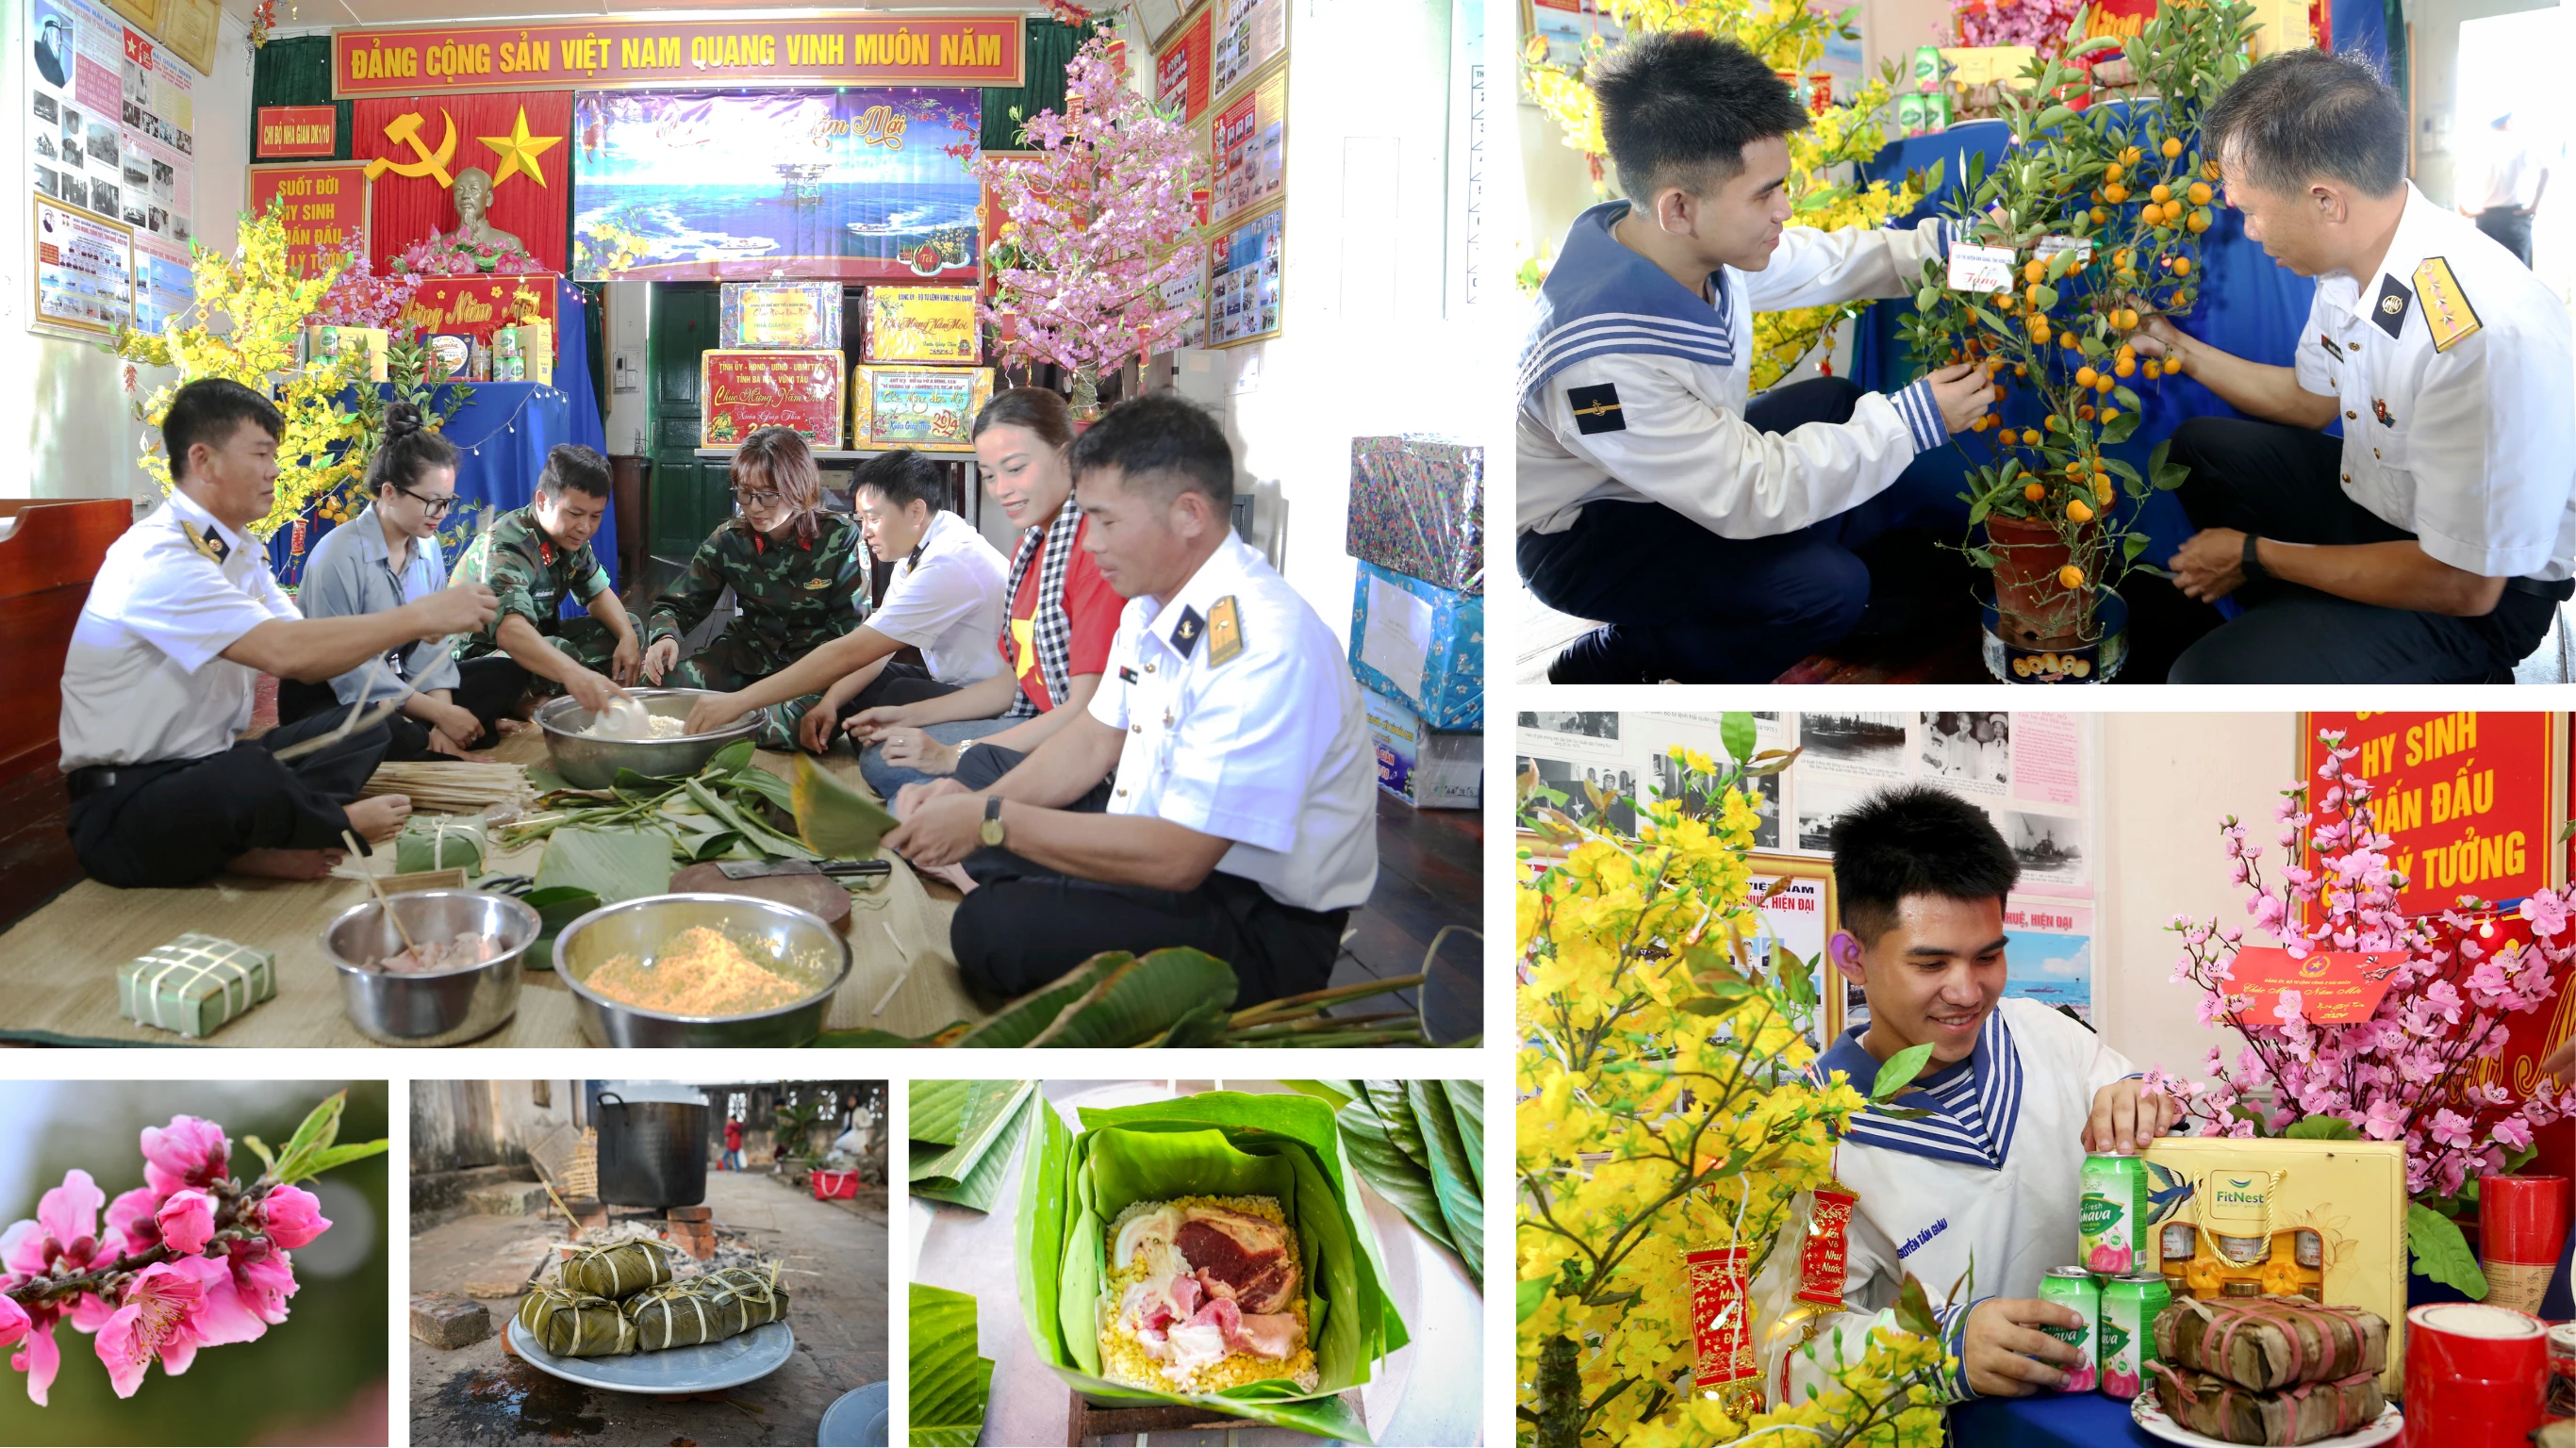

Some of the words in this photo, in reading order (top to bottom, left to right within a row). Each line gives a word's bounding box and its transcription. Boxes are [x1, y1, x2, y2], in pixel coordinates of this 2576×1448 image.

[351, 38, 417, 79] ĐẢNG
[426, 38, 490, 83] CỘNG
[500, 32, 550, 74] SẢN
[561, 32, 611, 76] VIỆT
[622, 37, 681, 69] NAM
[691, 34, 775, 71] QUANG
[786, 34, 844, 66] VINH
[854, 27, 930, 66] MUÔN
[940, 27, 1001, 66] NĂM
[264, 124, 274, 145] CHI
[274, 121, 283, 151] BỘ
[284, 119, 295, 144] NHÀ
[310, 124, 330, 146] DK1/10
[851, 105, 907, 150] Mới
[278, 175, 313, 197] SUỐT
[316, 174, 339, 195] ĐỜI
[303, 203, 336, 221] SINH
[284, 223, 310, 246] HẤN
[314, 222, 342, 245] ĐẤU
[445, 290, 493, 324] Năm
[719, 360, 734, 371] TỈNH
[735, 360, 743, 371] ỦY
[771, 363, 787, 371] UBND
[736, 373, 751, 384] TỈNH
[797, 373, 808, 384] TÀU
[715, 385, 739, 406] Chúc
[739, 387, 773, 407] Mừng
[771, 387, 801, 407] Năm
[932, 409, 959, 437] 2024
[2362, 732, 2397, 780] HY
[2405, 712, 2476, 767] SINH
[2349, 779, 2422, 835] HẤN
[2431, 758, 2494, 824] ĐẤU
[2421, 826, 2526, 890] TƯỞNG
[1772, 895, 1795, 912] HIỆN
[1797, 898, 1814, 913] ĐẠI
[2004, 911, 2028, 928] HUỆ,
[2030, 912, 2055, 930] HIỆN
[2056, 915, 2072, 931] ĐẠI
[2217, 1191, 2265, 1204] FitNest
[2079, 1209, 2111, 1224] Guava
[1896, 1238, 1920, 1259] GUYỄN
[1917, 1228, 1933, 1244] TẤN
[1825, 1250, 1842, 1261] Như
[1822, 1262, 1842, 1274] Nước
[2102, 1334, 2119, 1345] ava
